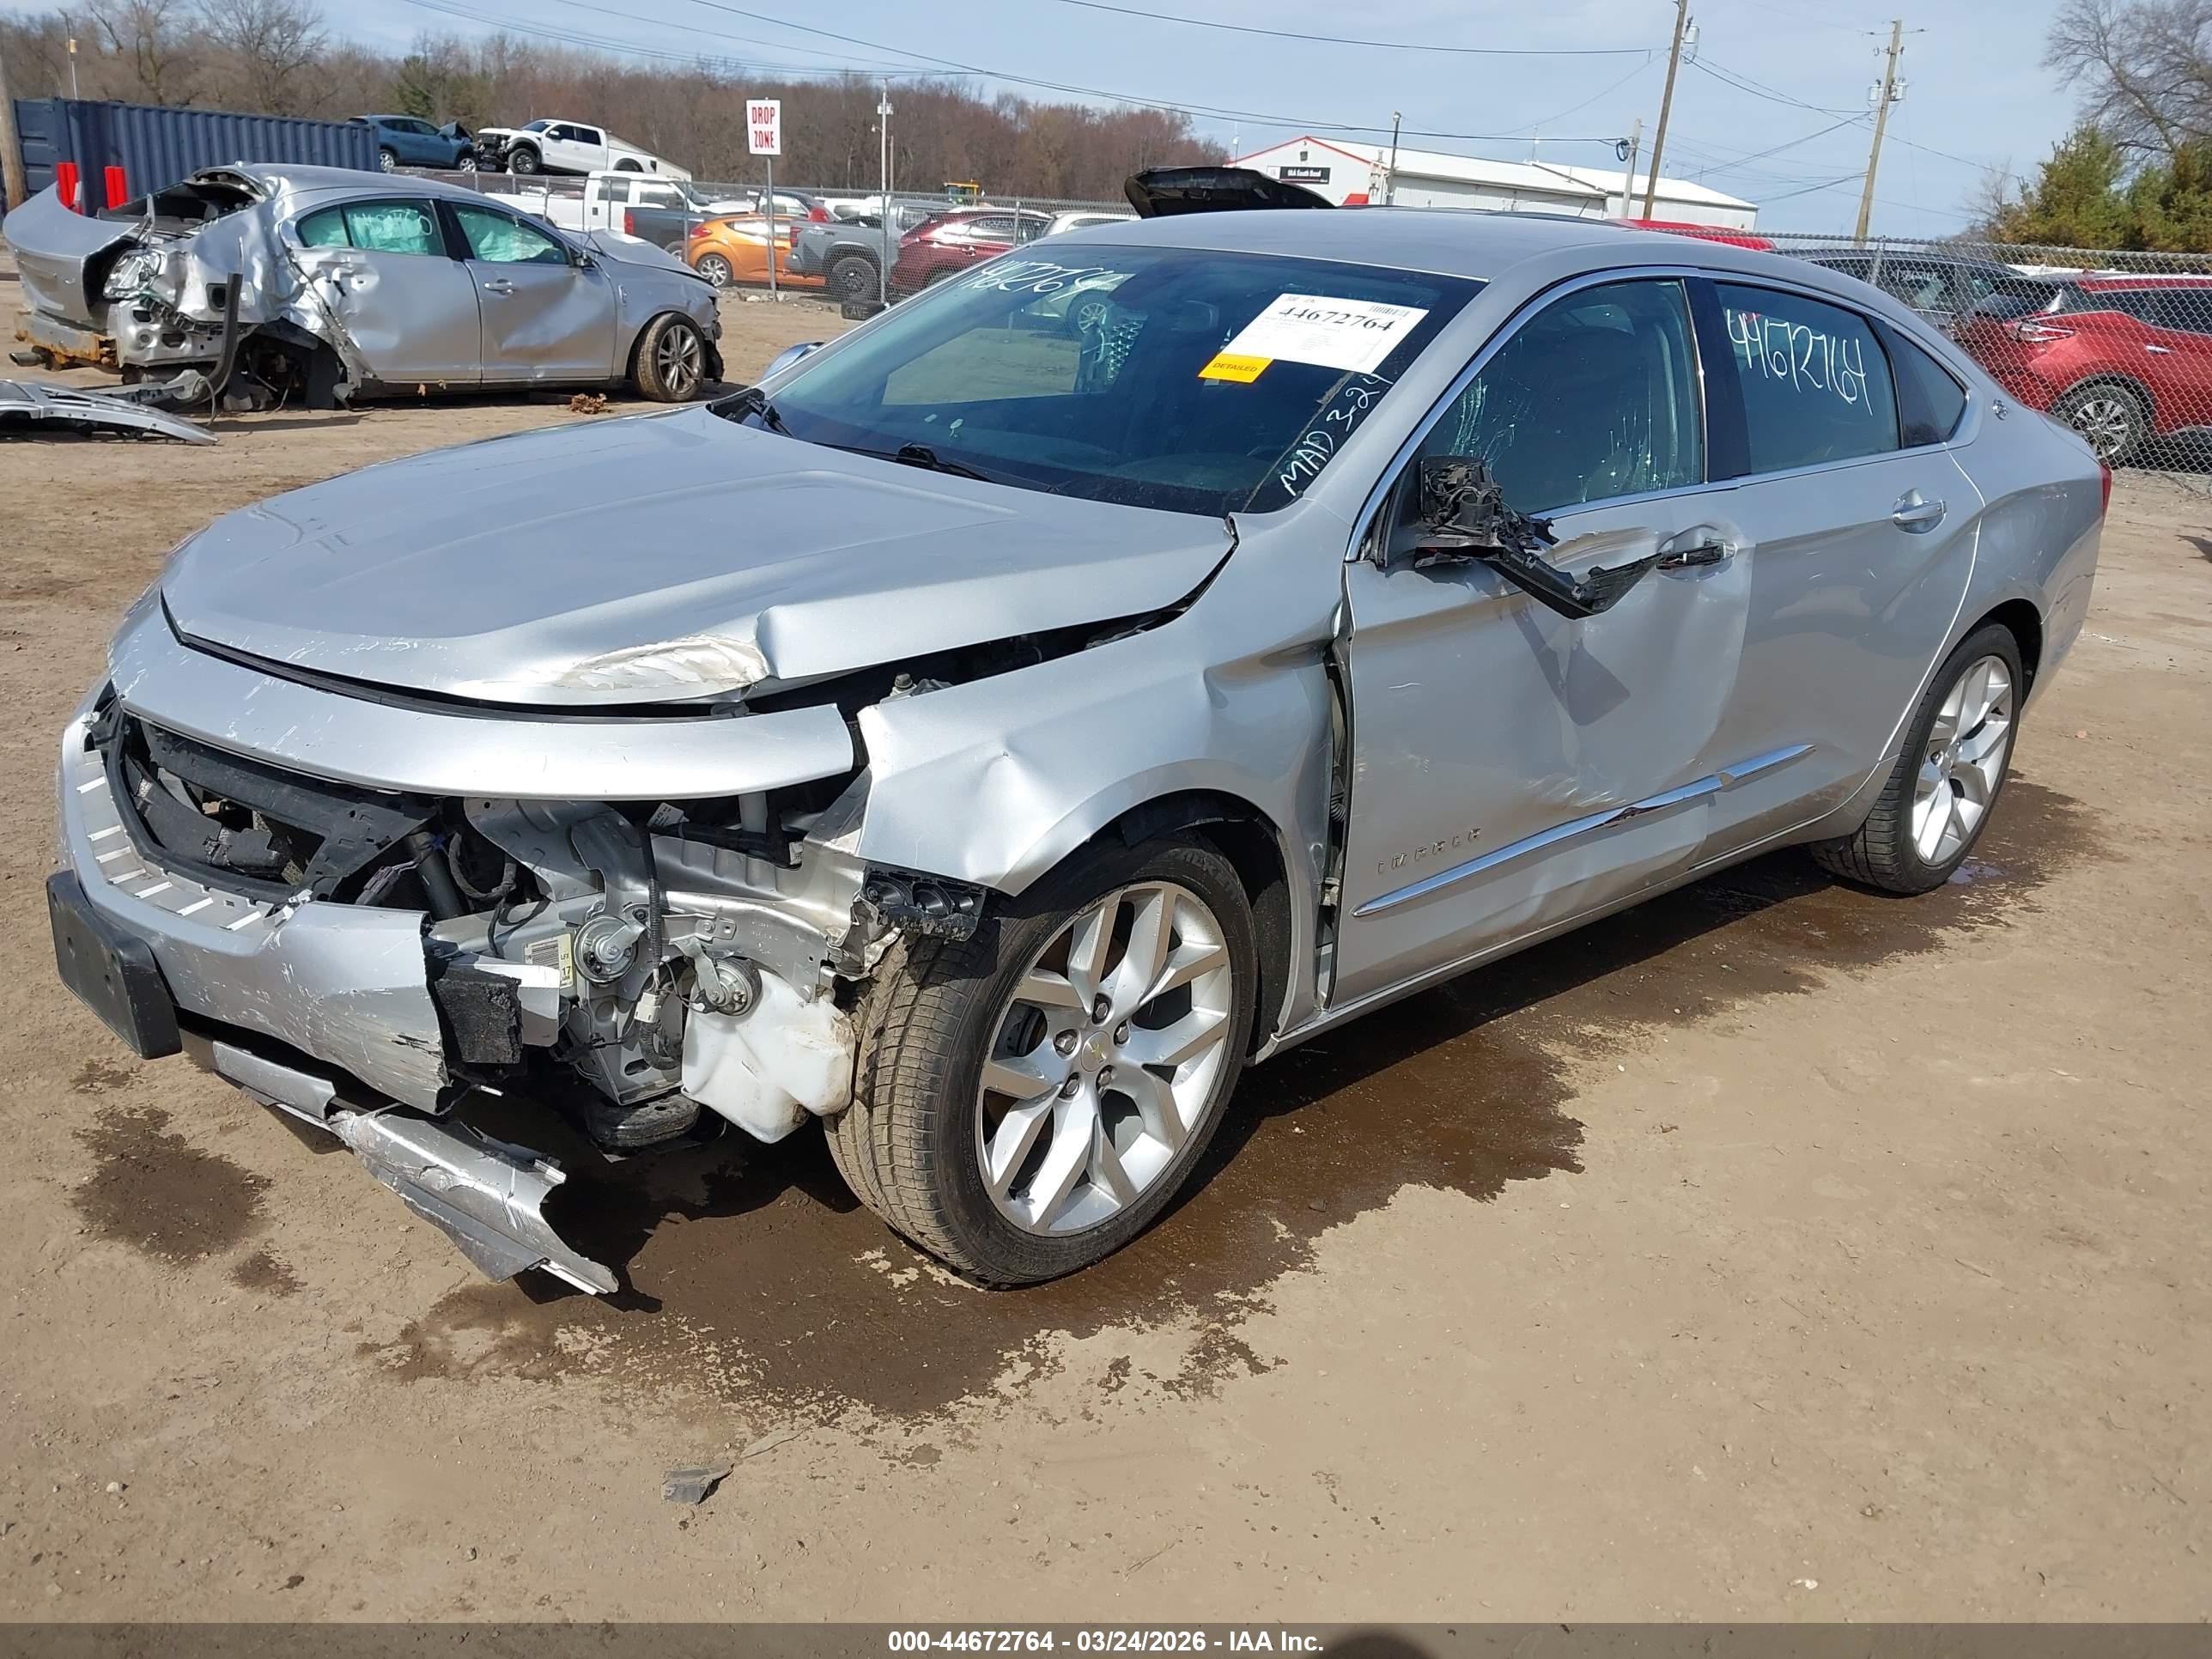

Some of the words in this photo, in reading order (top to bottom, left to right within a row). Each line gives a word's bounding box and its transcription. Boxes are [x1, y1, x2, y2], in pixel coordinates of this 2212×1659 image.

[751, 106, 775, 125] DROP
[754, 130, 775, 149] ZONE
[1279, 306, 1396, 332] 44672764
[1212, 362, 1259, 373] DETAILED
[1726, 308, 1873, 416] 44672764
[1280, 430, 1334, 496] MAD
